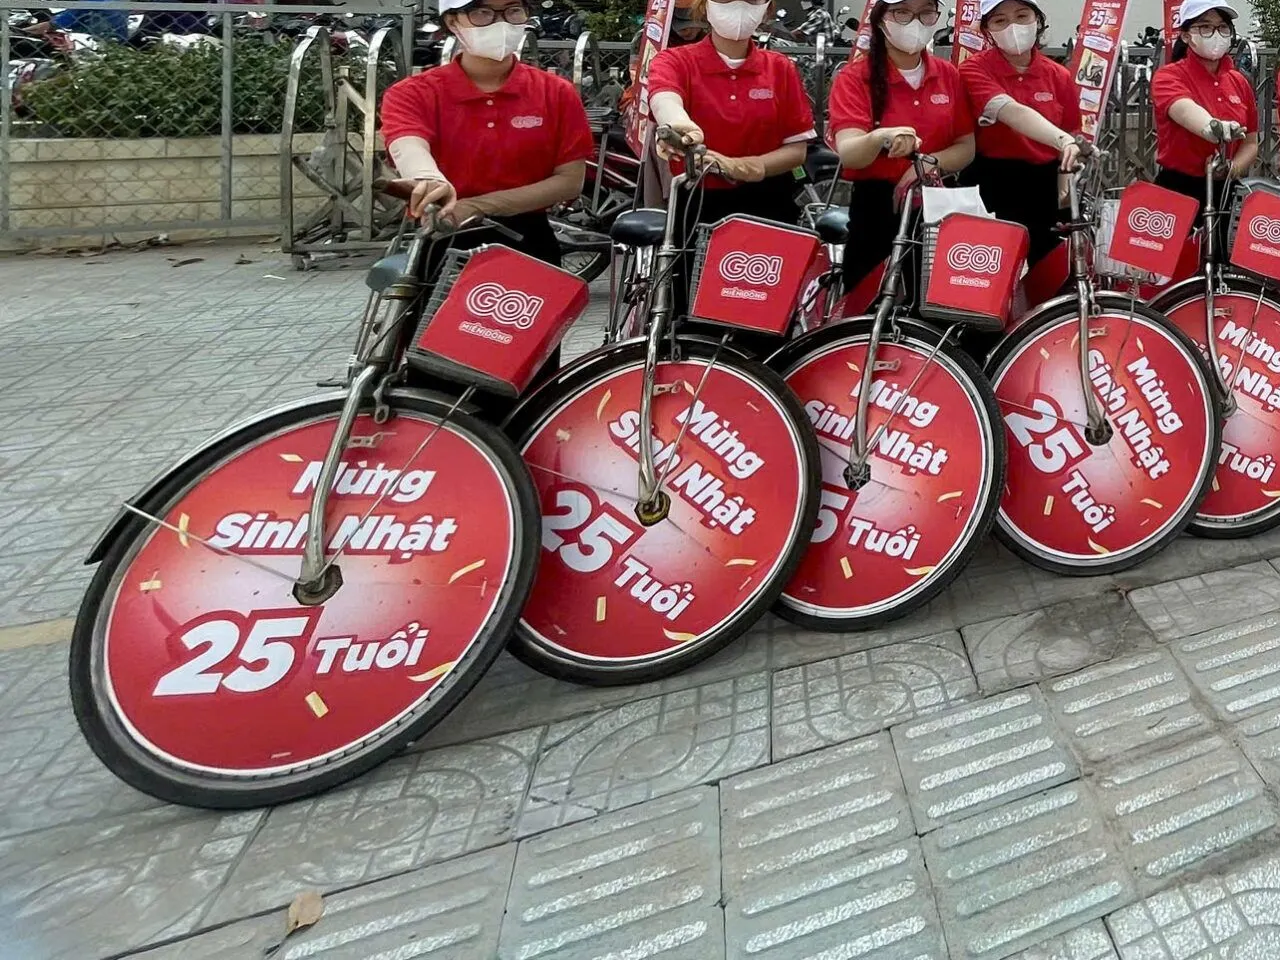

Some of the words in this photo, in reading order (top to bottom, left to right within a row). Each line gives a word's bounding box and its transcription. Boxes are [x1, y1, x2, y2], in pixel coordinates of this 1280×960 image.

[1088, 10, 1106, 27] 25
[1128, 206, 1177, 240] GO!
[719, 250, 784, 287] GO!
[947, 242, 1003, 275] GO!
[466, 282, 545, 330] GO!
[1126, 356, 1184, 435] Mừng
[676, 399, 766, 480] Mừng
[867, 424, 950, 476] Nhật
[1003, 398, 1084, 474] 25
[1061, 469, 1117, 534] Tuổi
[1117, 408, 1171, 480] Nhật
[1219, 442, 1277, 484] Tuổi
[672, 460, 758, 536] Nhật
[810, 489, 850, 544] 5
[848, 517, 922, 561] Tuổi
[329, 514, 458, 560] Nhật
[541, 489, 636, 573] 25
[613, 555, 696, 621] Tuổi
[152, 616, 311, 698] 25
[314, 621, 430, 674] Tuổi
